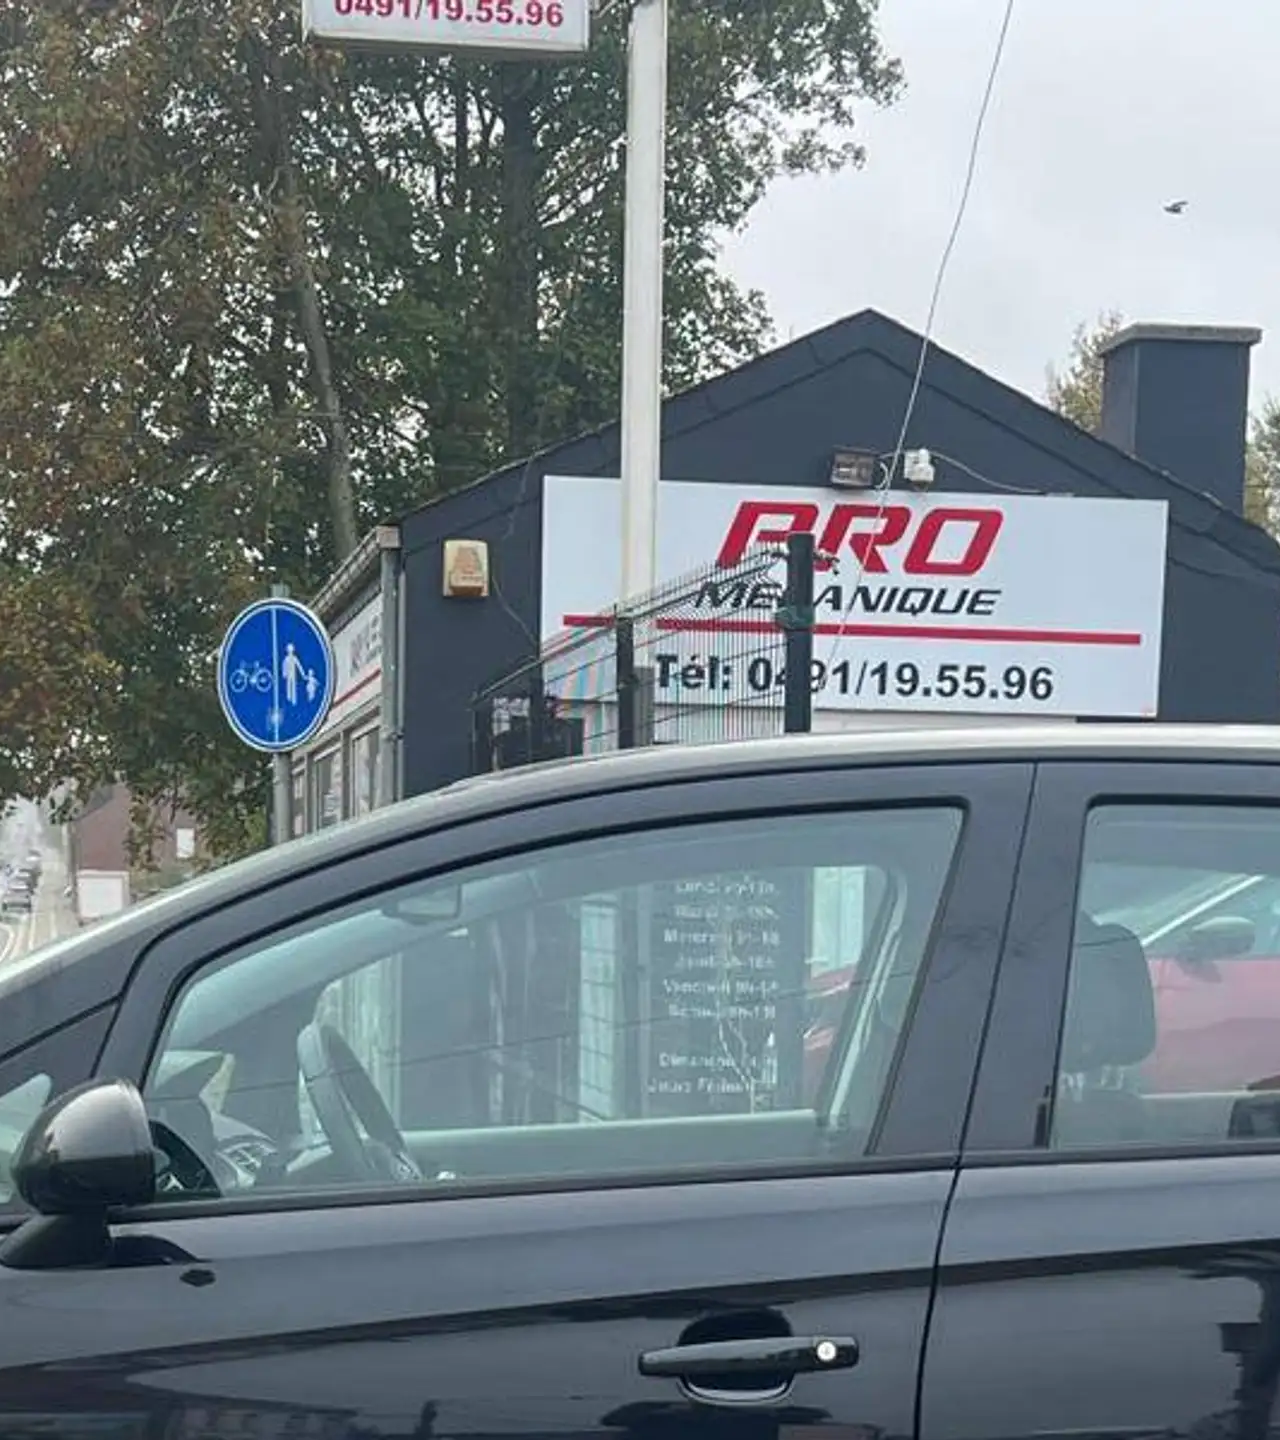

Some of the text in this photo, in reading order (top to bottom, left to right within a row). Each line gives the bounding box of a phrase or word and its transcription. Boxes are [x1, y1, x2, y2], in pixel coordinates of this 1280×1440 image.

[717, 500, 1004, 576] PRO
[695, 581, 1002, 616] MEANIQUE
[656, 653, 731, 691] Tél:
